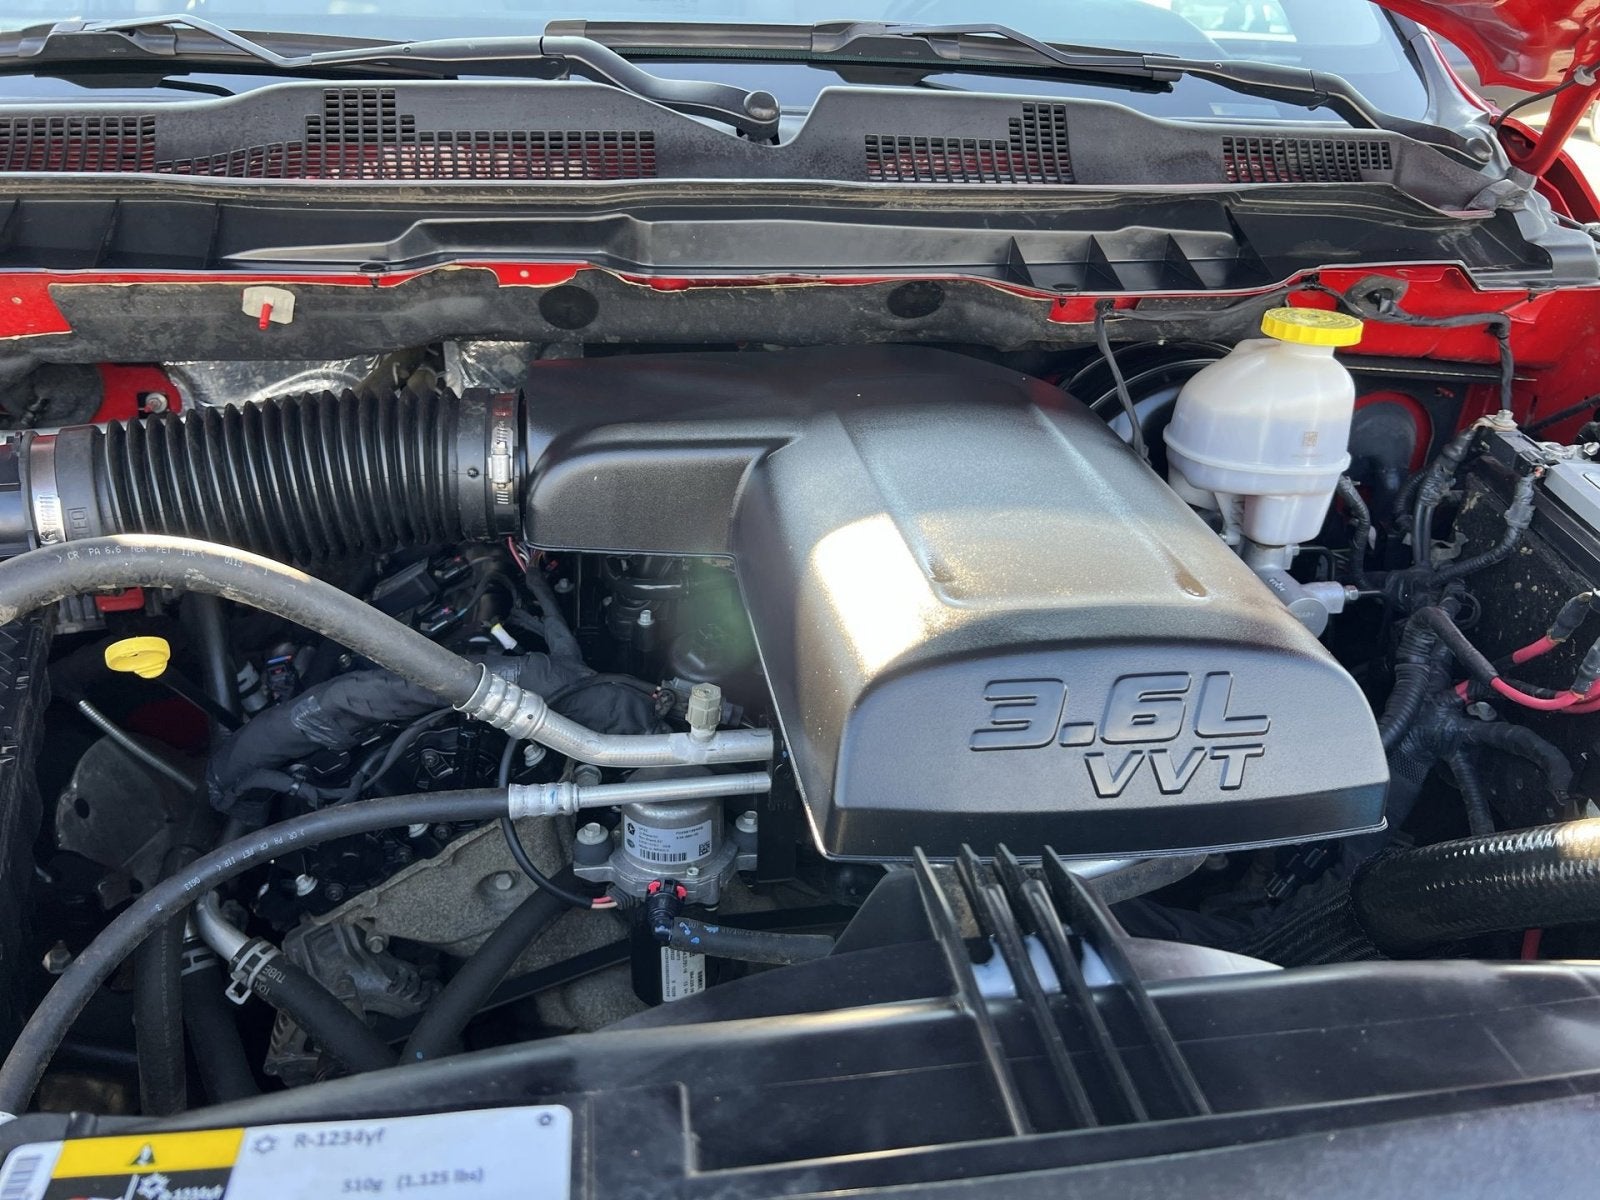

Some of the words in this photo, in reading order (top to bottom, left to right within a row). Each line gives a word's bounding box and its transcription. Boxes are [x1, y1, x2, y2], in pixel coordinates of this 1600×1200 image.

[88, 547, 101, 557] PA
[104, 545, 122, 554] 6.6
[969, 670, 1271, 752] 3.6L
[1084, 743, 1265, 799] VVT
[263, 964, 287, 984] TUBE
[293, 1126, 386, 1150] R-1234yf
